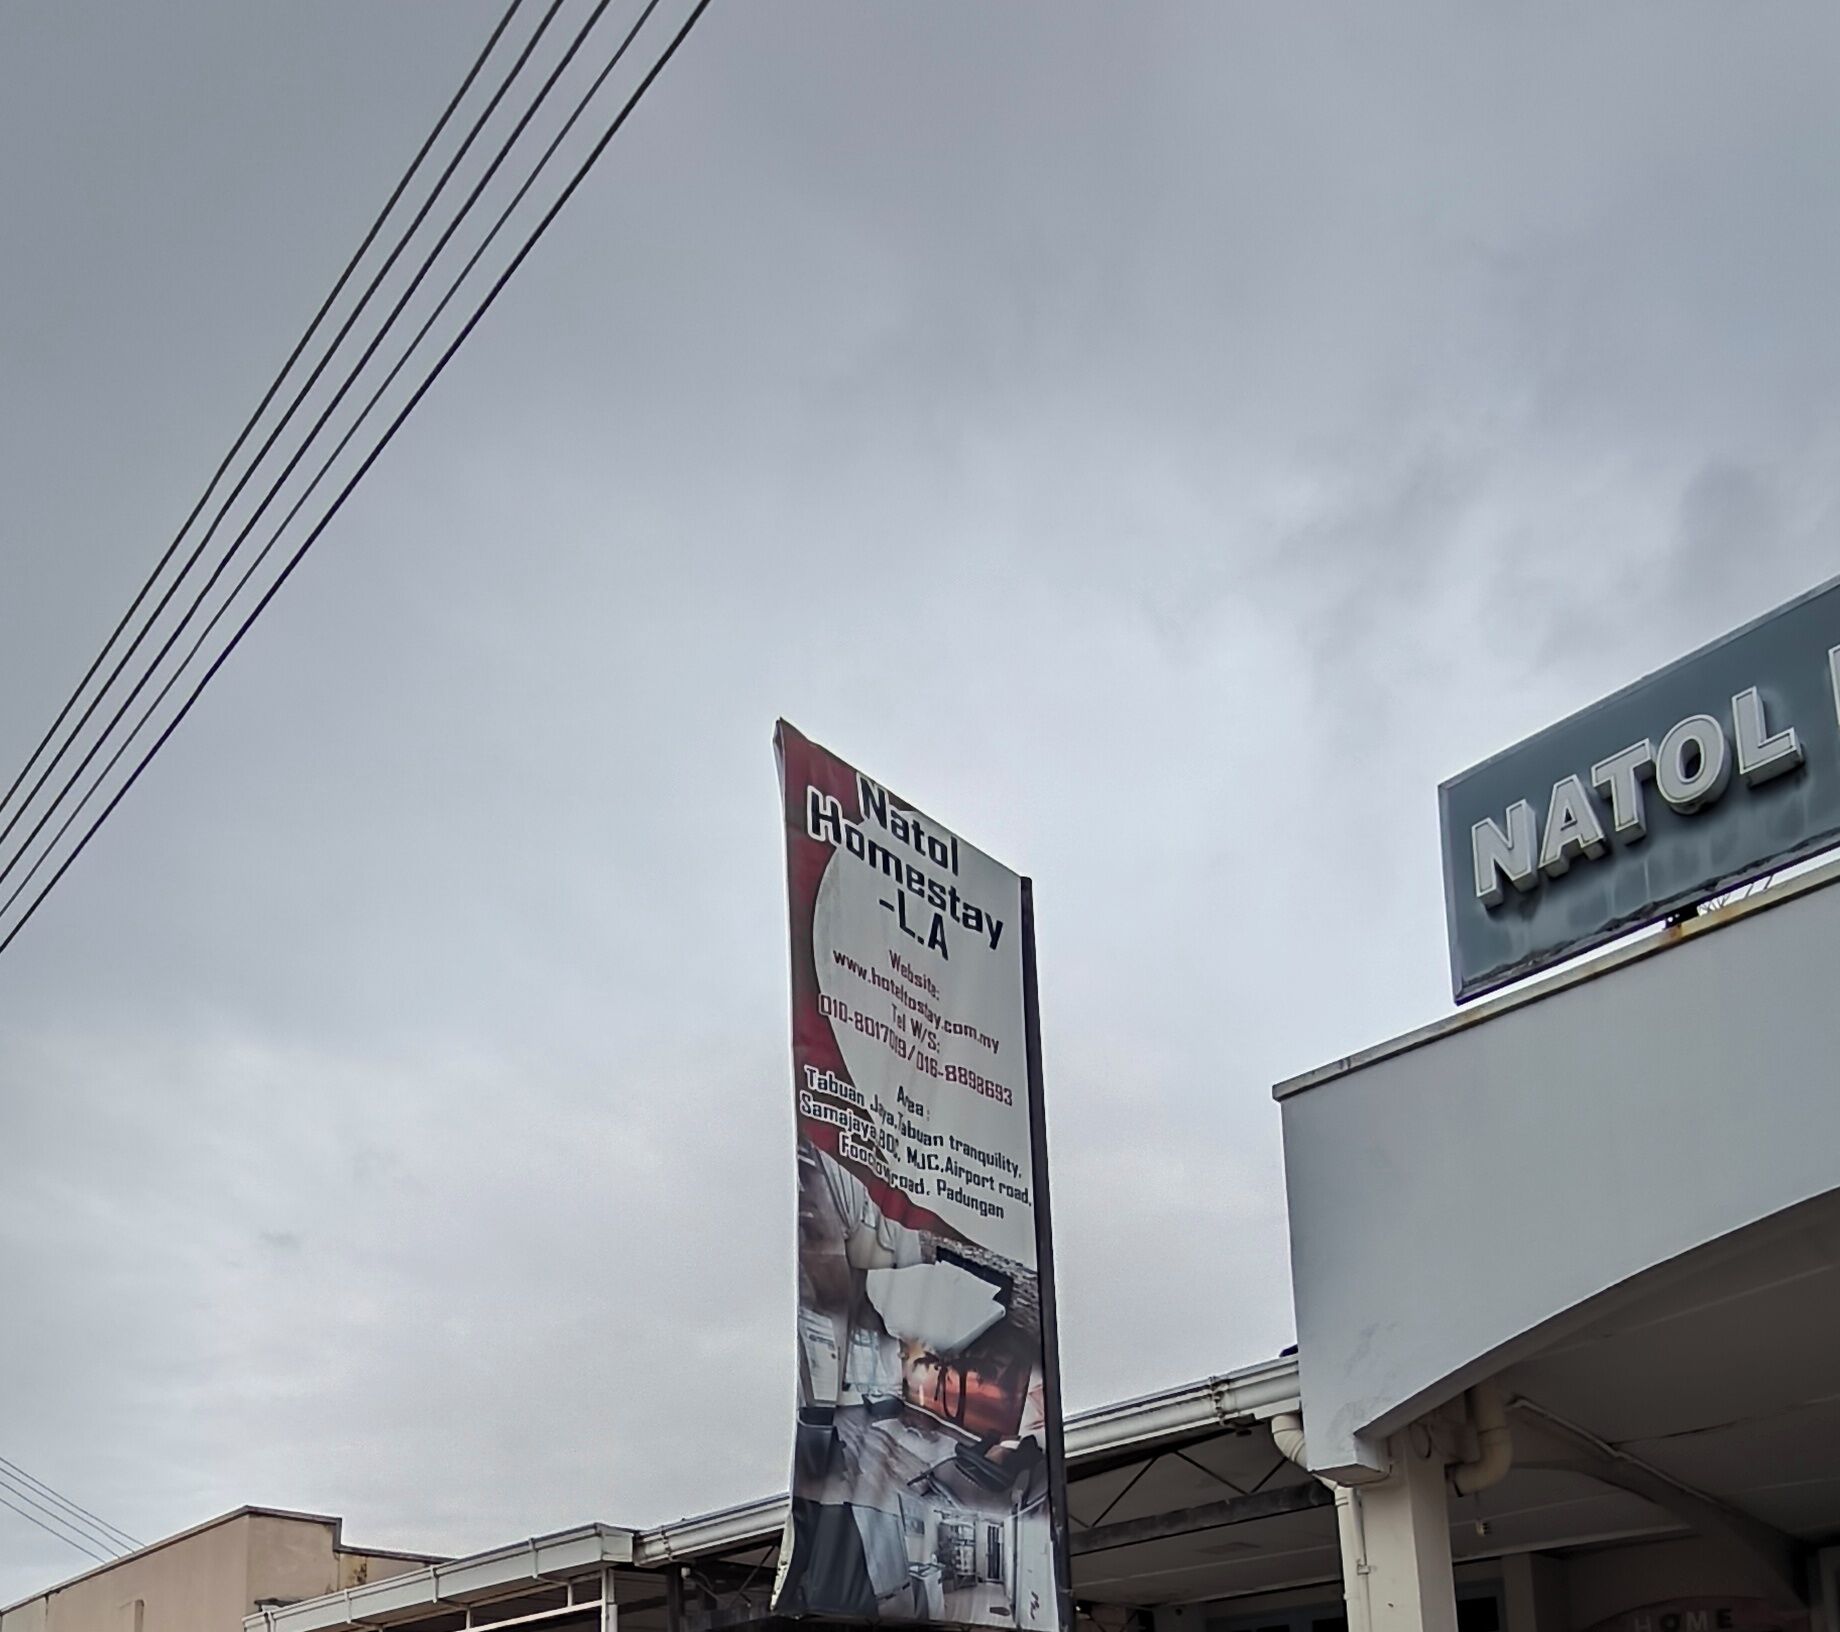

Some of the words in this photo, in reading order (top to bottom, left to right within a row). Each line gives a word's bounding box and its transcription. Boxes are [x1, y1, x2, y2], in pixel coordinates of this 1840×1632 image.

[859, 776, 959, 877] Natol
[1471, 686, 1802, 906] NATOL
[810, 789, 1004, 951] Homestay
[879, 888, 949, 961] -L.A
[832, 949, 1000, 1055] www.hoteltostay.com.my
[888, 949, 940, 1001] Website:
[891, 1002, 906, 1032] Tel
[910, 1017, 941, 1054] W/S:
[804, 1067, 865, 1108] Tabuan
[842, 1134, 891, 1181] Foocow
[936, 1178, 1004, 1219] Padungan
